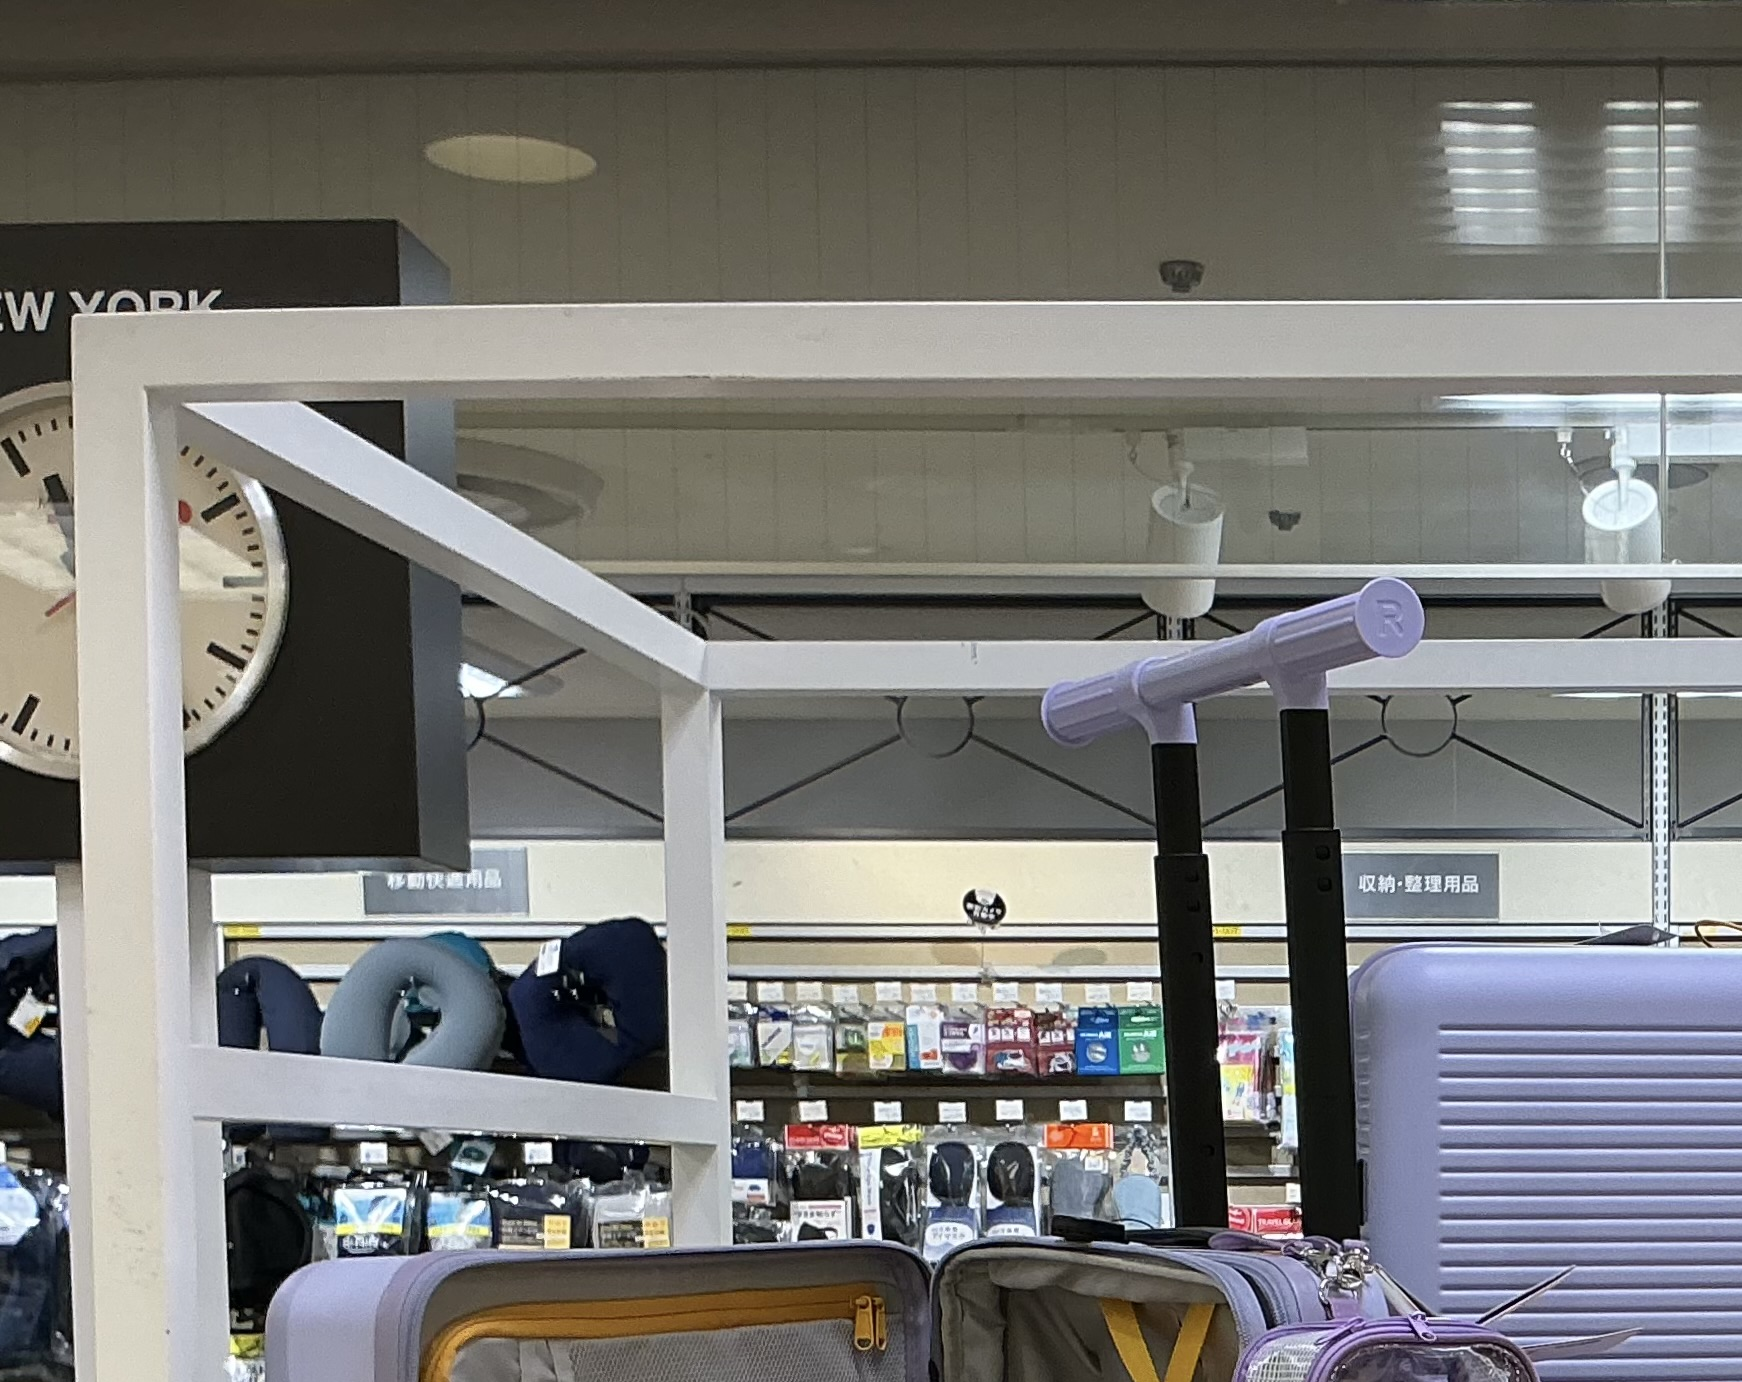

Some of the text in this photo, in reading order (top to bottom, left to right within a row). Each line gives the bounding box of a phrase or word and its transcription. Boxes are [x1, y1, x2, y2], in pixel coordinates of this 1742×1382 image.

[0, 291, 55, 332] W
[1358, 875, 1479, 893] 収納・整理用品
